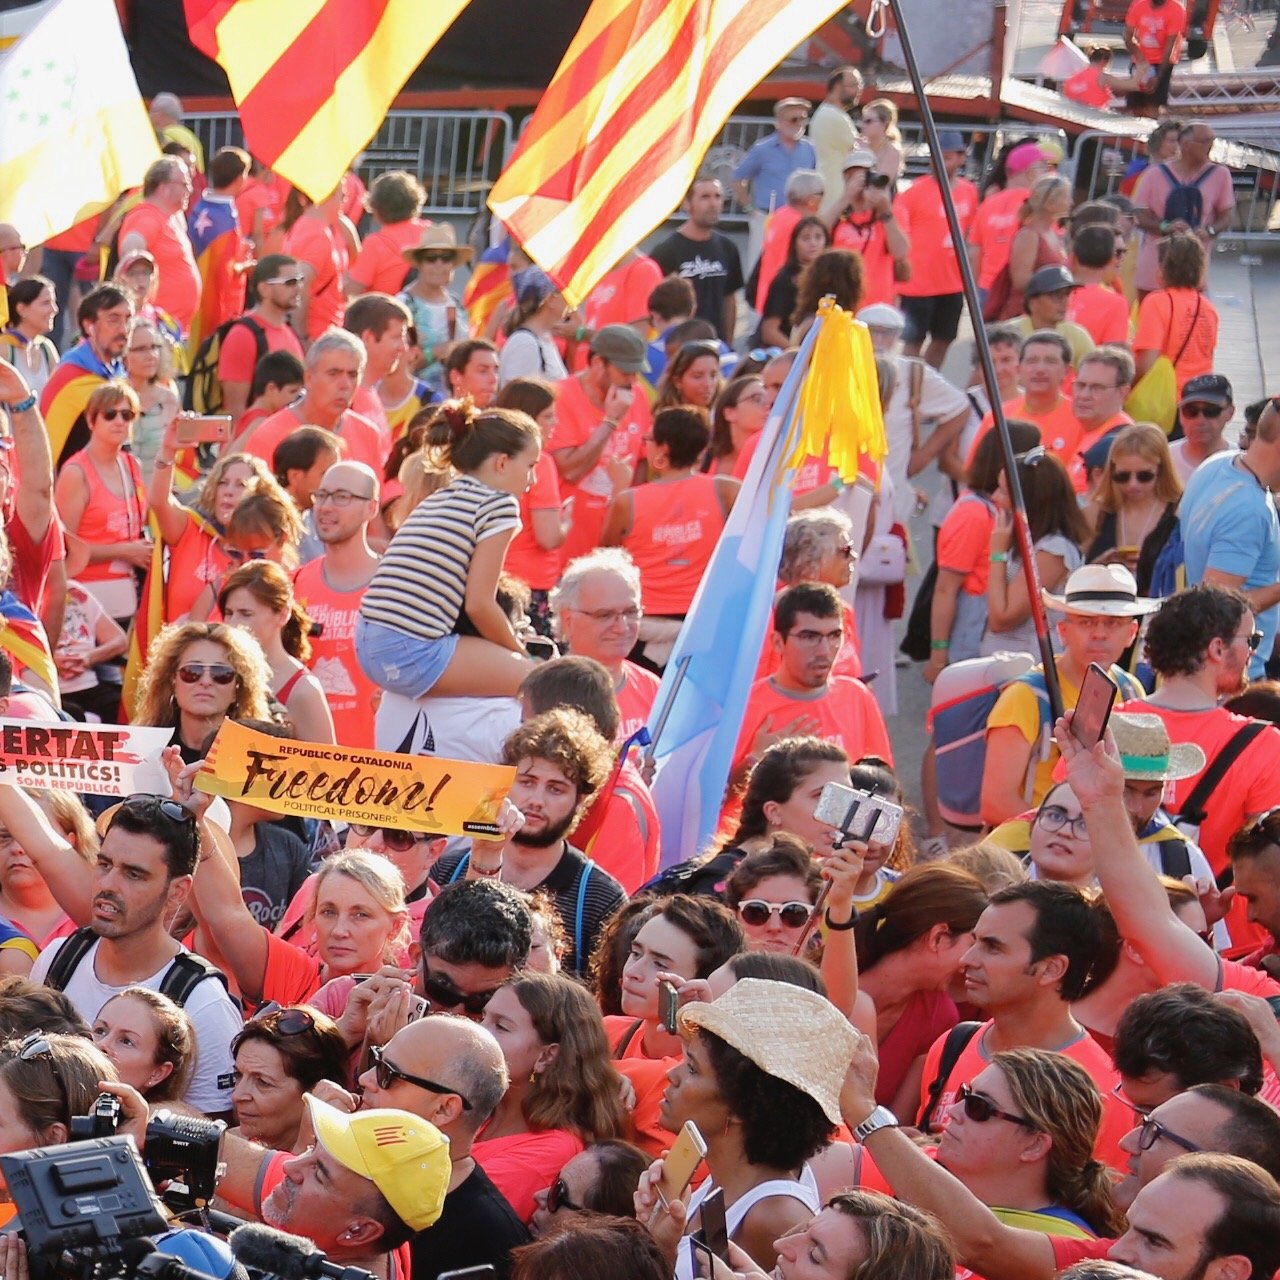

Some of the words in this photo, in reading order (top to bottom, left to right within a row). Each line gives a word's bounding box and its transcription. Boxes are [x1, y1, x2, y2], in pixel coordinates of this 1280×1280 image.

[16, 756, 122, 782] POLÍTICS!
[279, 744, 330, 762] REPUBLIC
[334, 750, 348, 763] OF
[351, 752, 413, 771] CATALONIA
[17, 774, 49, 788] SOM
[54, 776, 122, 796] REPÚBLICA
[246, 747, 453, 814] Freedom!
[284, 800, 337, 816] POLITICAL
[338, 807, 400, 825] PRISONERS
